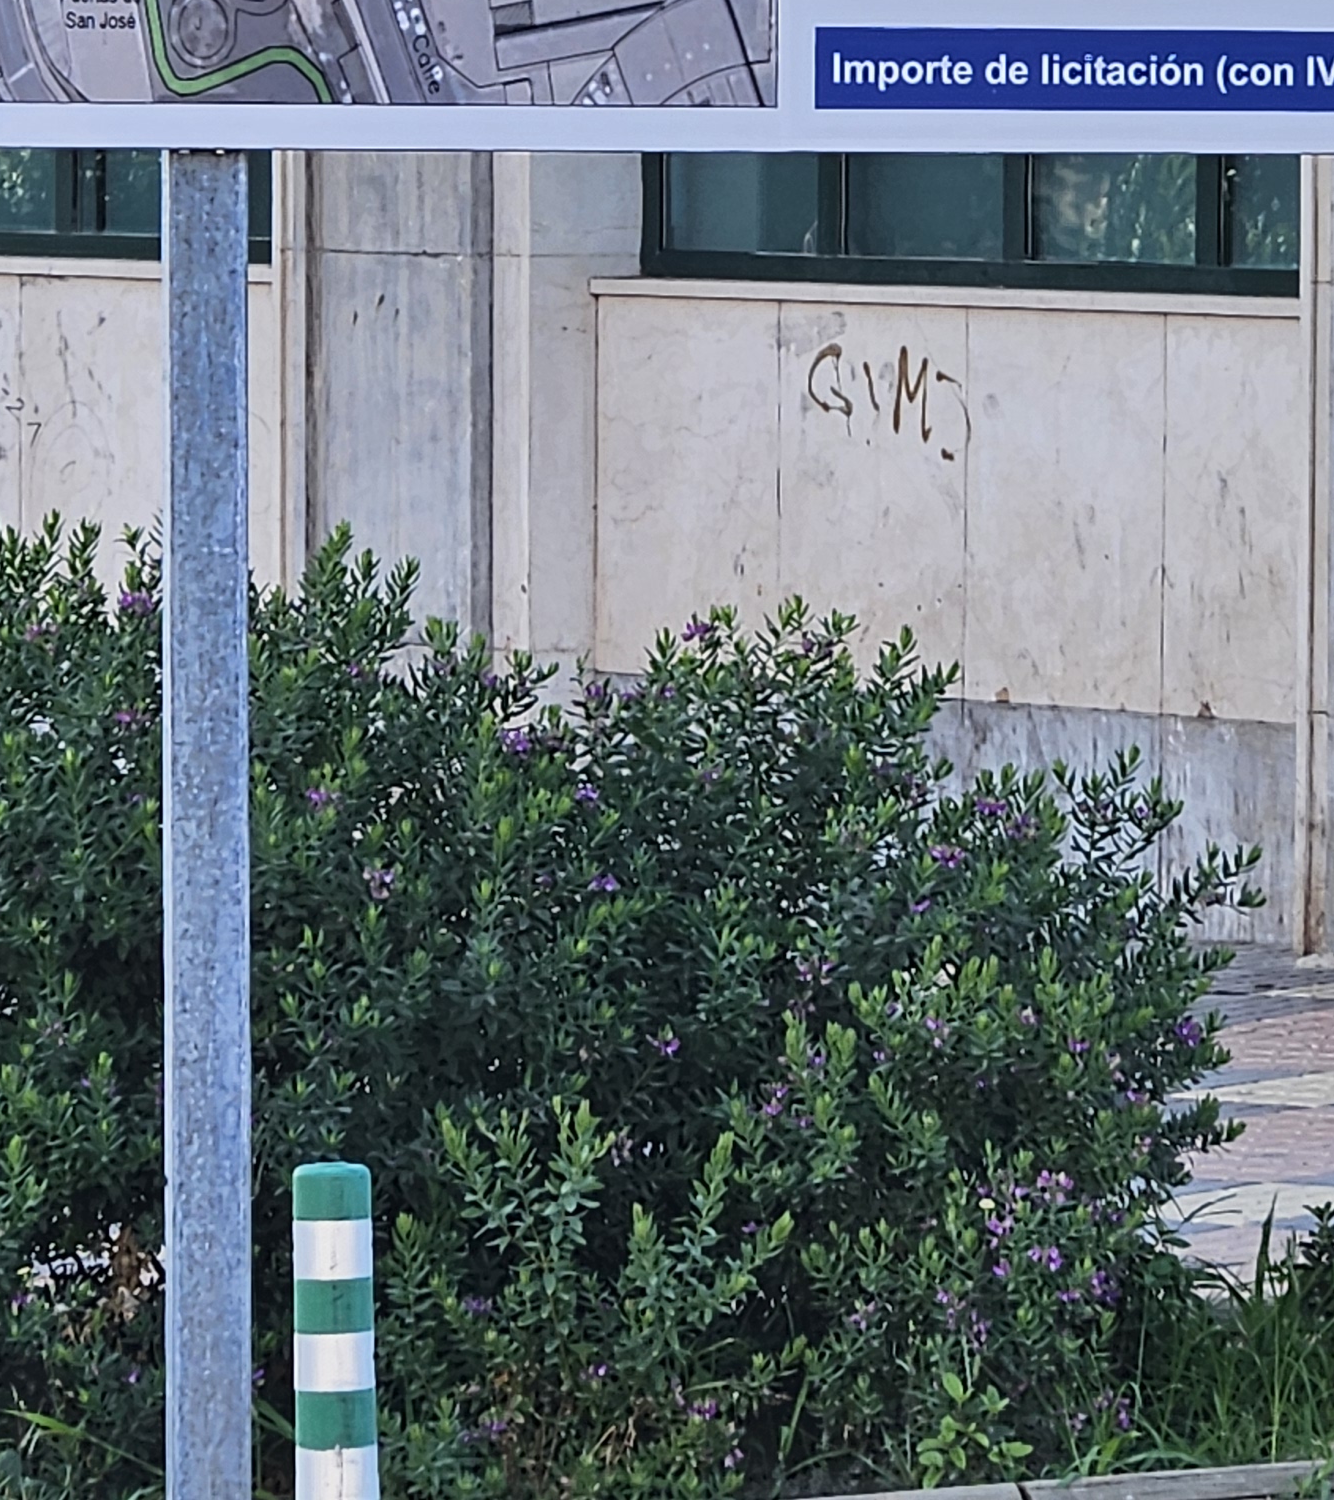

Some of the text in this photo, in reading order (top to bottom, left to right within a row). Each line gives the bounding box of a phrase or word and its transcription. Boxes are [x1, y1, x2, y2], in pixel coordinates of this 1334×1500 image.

[66, 11, 136, 29] San José
[833, 52, 973, 92] Importe
[984, 53, 1029, 85] de
[1041, 53, 1204, 86] licitación
[1216, 55, 1294, 94] (con
